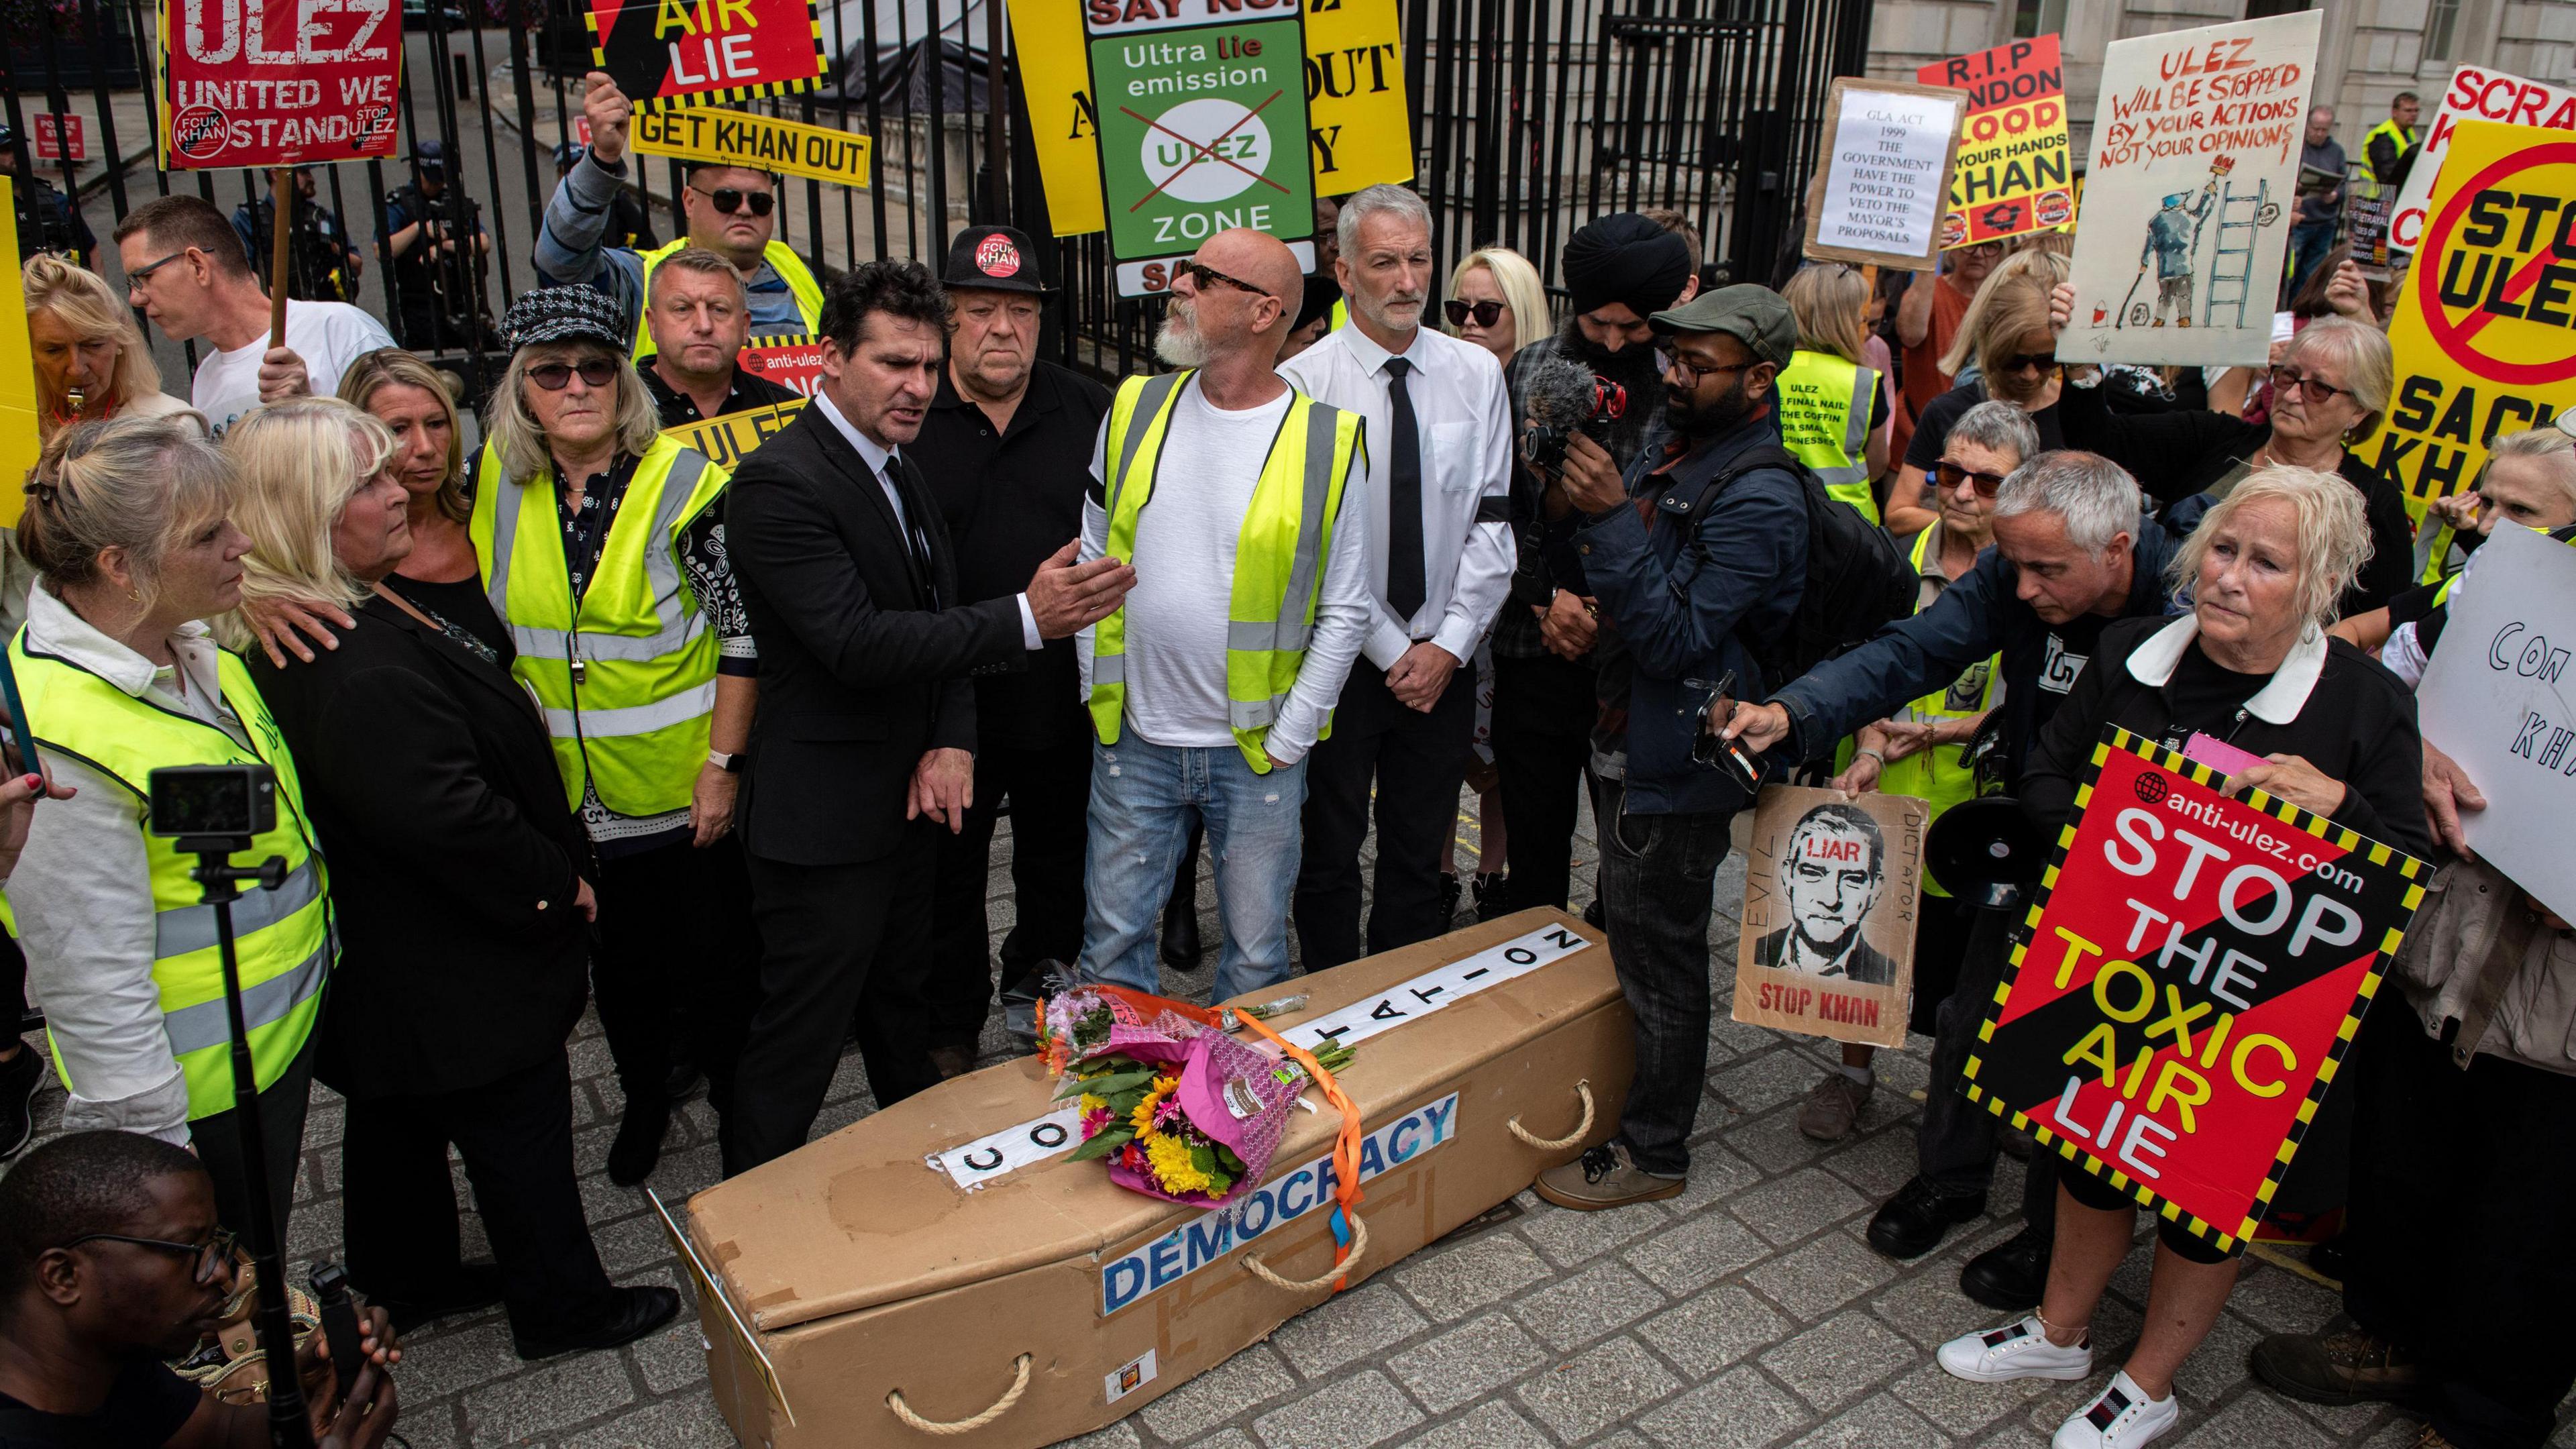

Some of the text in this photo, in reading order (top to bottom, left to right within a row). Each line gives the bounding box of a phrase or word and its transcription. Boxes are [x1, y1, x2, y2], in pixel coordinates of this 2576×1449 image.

[185, 0, 390, 64] ULEZ
[668, 33, 759, 86] LIE
[1123, 35, 1263, 68] Ultra lie
[1947, 42, 2032, 86] R.I.P
[2160, 37, 2256, 82] ULEZ
[178, 75, 392, 110] UNITED WE
[1128, 66, 1267, 97] emission
[2112, 63, 2301, 121] WILL BE STOPPED
[182, 116, 220, 129] FCUK
[349, 117, 395, 136] ULEZ
[356, 107, 388, 120] STOP
[1866, 109, 1925, 125] GLA ACT
[2107, 96, 2300, 149] BY YOUR ACTIONS
[177, 127, 225, 142] KHAN
[230, 115, 349, 148] STAND
[639, 113, 864, 175] GET KHAN OUT
[1878, 140, 1903, 154] THE
[1880, 125, 1907, 138] 1999
[1157, 134, 1257, 167] ULEZ
[1842, 151, 1933, 172] GOVERNMENT
[1956, 133, 2068, 169] YOUR HANDS
[2100, 141, 2145, 170] NOT
[2145, 136, 2194, 171] YOUR
[1849, 182, 1915, 200] POWER TO
[1853, 168, 1916, 185] HAVE THE
[1847, 212, 1905, 228] MAYOR'S
[1849, 197, 1911, 214] VETO THE
[1152, 204, 1273, 243] ZONE
[1837, 225, 1911, 244] PROPOSALS
[978, 252, 1018, 268] KHAN
[983, 243, 1015, 256] FCUK
[2439, 250, 2576, 329] ULE
[1786, 398, 1817, 407] FINAL
[1820, 400, 1845, 410] NAIL
[1790, 384, 1819, 394] ULEZ
[1780, 411, 1841, 423] THE COFFIN
[1799, 424, 1830, 434] SMALL
[2375, 431, 2483, 498] KH
[1807, 839, 1862, 863] LIAR
[2167, 789, 2364, 894] anti-ulez.com
[1747, 835, 1775, 928] EVIL
[1896, 812, 1921, 923] DICTATOR
[2104, 807, 2363, 957] STOP
[2126, 898, 2267, 1010] THE
[1758, 983, 1879, 1028] STOP KHAN
[2054, 926, 2298, 1099] TOXIC
[2062, 1023, 2212, 1134] AIR
[2053, 1075, 2178, 1179] LIE
